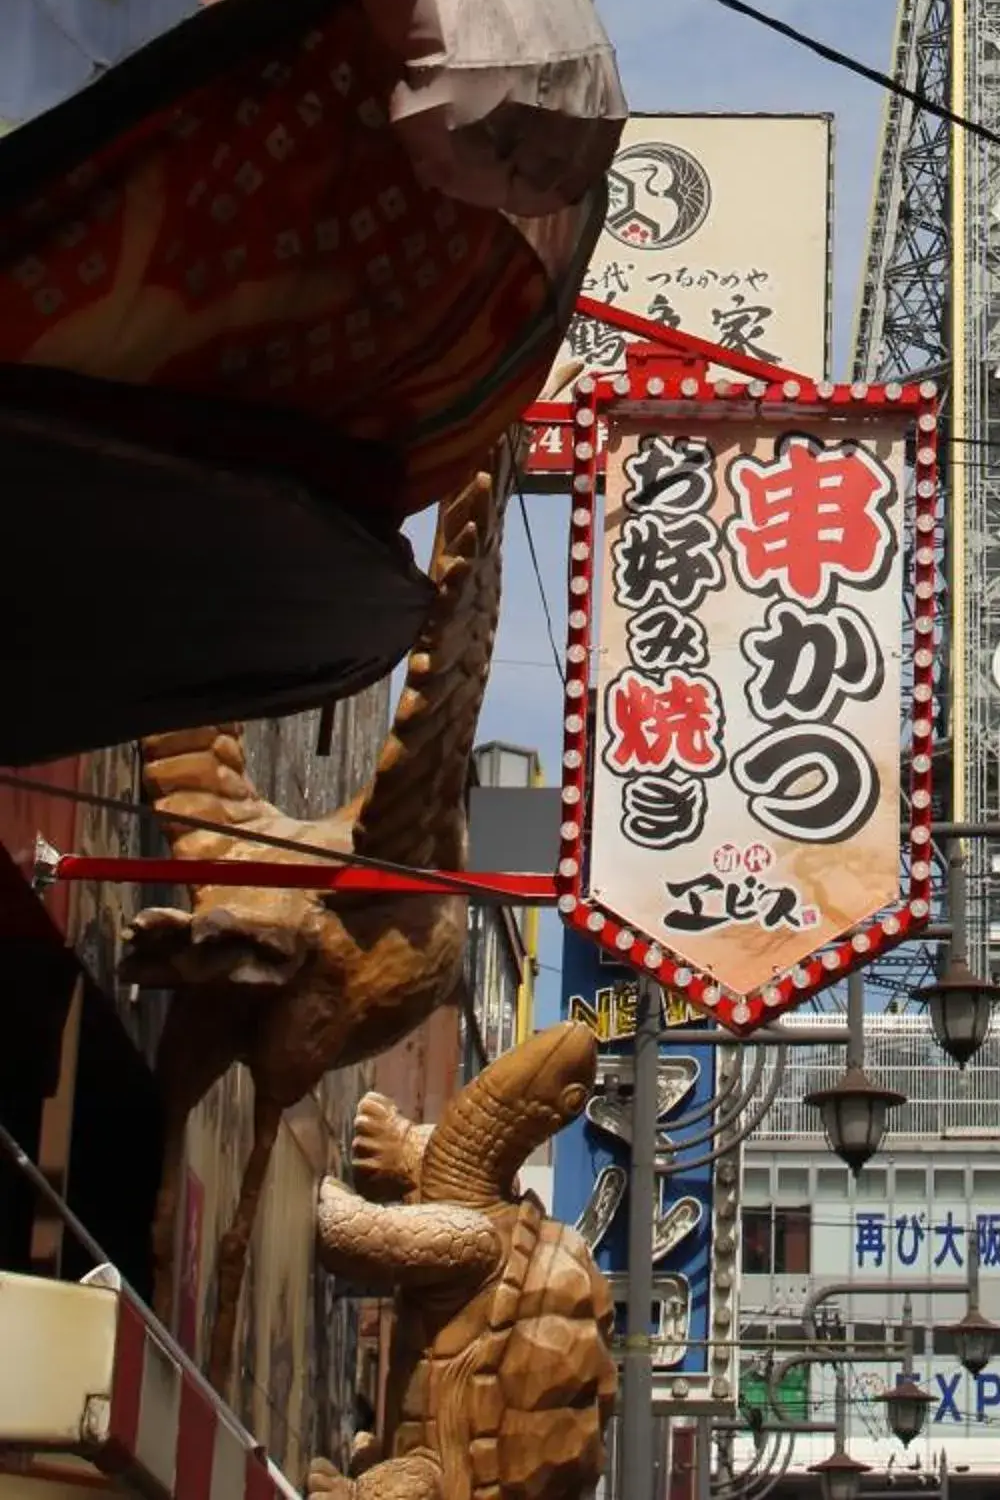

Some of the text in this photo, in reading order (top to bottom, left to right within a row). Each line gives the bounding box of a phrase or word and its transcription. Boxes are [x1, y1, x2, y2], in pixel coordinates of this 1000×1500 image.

[604, 438, 724, 847] お好み焼き
[729, 436, 892, 843] 串かつ
[663, 873, 801, 932] エビス
